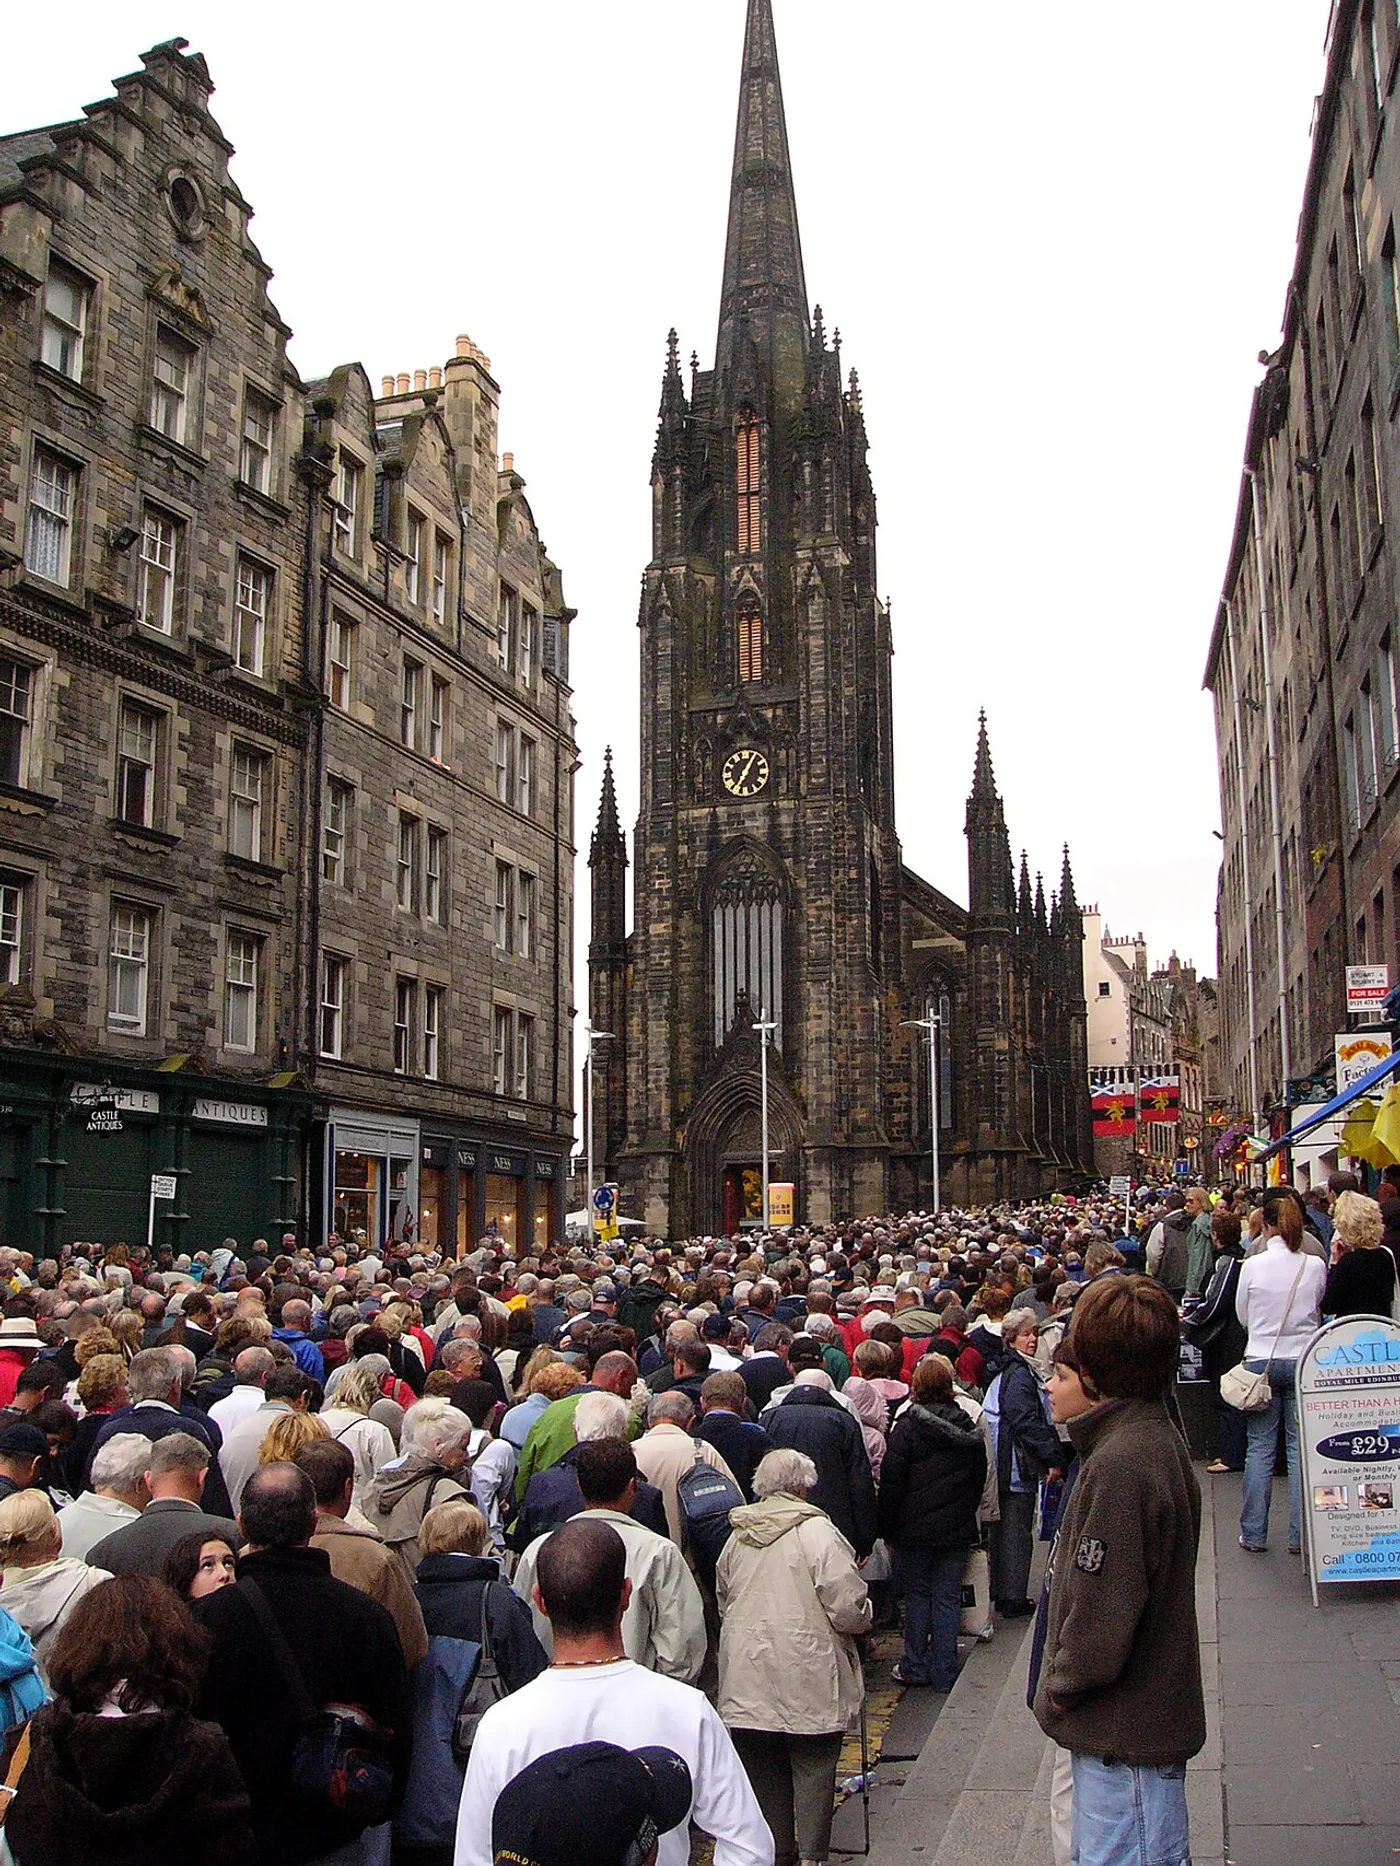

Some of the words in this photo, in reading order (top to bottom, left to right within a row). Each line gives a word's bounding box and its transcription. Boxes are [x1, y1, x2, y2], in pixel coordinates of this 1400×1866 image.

[1368, 989, 1385, 997] SALE
[90, 1110, 120, 1121] CASTLE
[86, 1120, 124, 1131] ANTIQUES
[458, 1151, 475, 1165] NESS
[494, 1156, 512, 1170] NESS
[536, 1161, 553, 1175] NESS
[1313, 1342, 1398, 1366] CASTL
[1315, 1379, 1342, 1387] ROYAL
[1344, 1377, 1365, 1385] MILE
[1306, 1400, 1349, 1411] BETTER
[1351, 1398, 1381, 1408] THAN
[1383, 1398, 1391, 1407] A
[1318, 1411, 1353, 1420] Holiday
[1357, 1410, 1374, 1418] and
[1351, 1436, 1389, 1455] £29
[1322, 1467, 1360, 1475] Available
[1362, 1465, 1395, 1474] Nightly,
[1364, 1473, 1397, 1481] Monthly
[1327, 1512, 1365, 1521] Designed
[1322, 1554, 1345, 1566] Call
[1355, 1552, 1385, 1564] 0800
